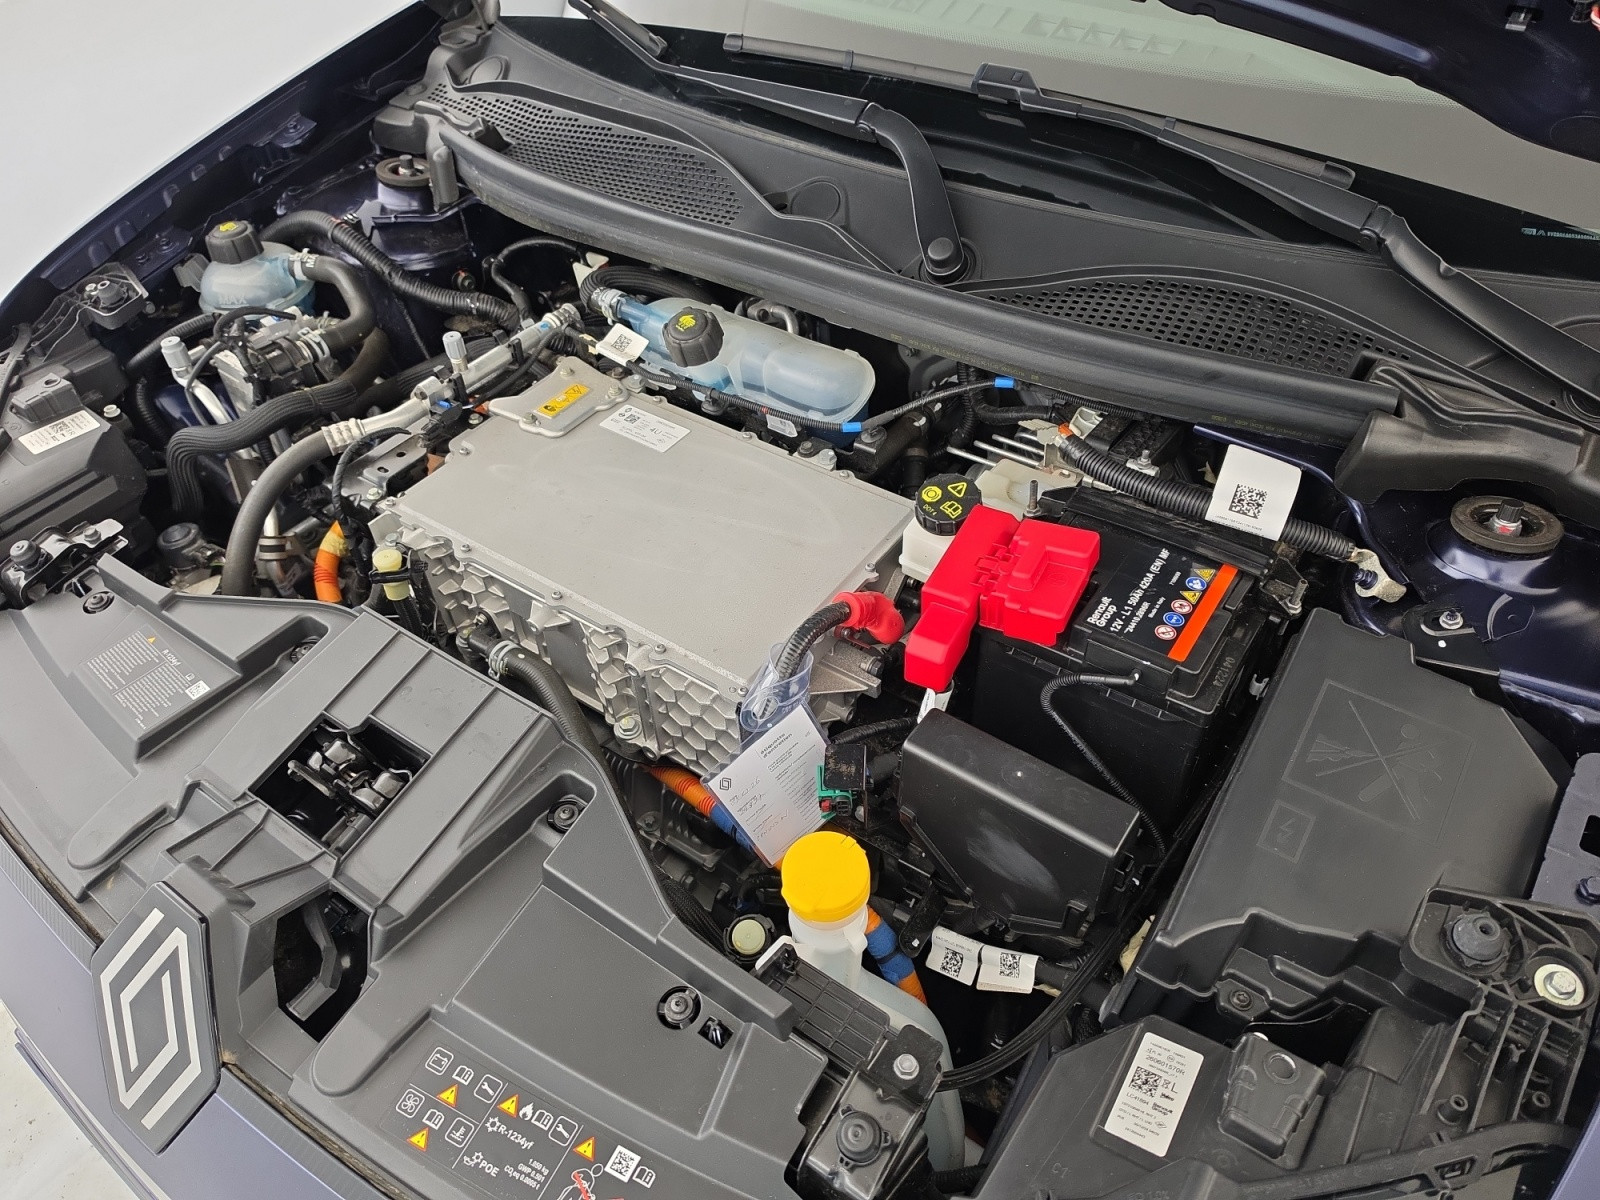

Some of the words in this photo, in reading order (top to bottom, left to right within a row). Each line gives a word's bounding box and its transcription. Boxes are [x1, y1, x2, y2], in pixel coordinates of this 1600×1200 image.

[1159, 548, 1171, 560] MF
[1149, 557, 1168, 575] (EN)
[1138, 571, 1156, 590] 420A
[1127, 587, 1146, 608] 50Ah
[1086, 596, 1113, 625] Renault
[1095, 604, 1119, 628] Group
[1125, 604, 1134, 617] L1
[1110, 620, 1125, 633] 12V
[1212, 656, 1235, 687] 041224
[498, 1124, 535, 1150] R-1234yf
[480, 1160, 499, 1177] POE
[517, 1163, 532, 1174] GWP
[541, 1165, 549, 1176] kg
